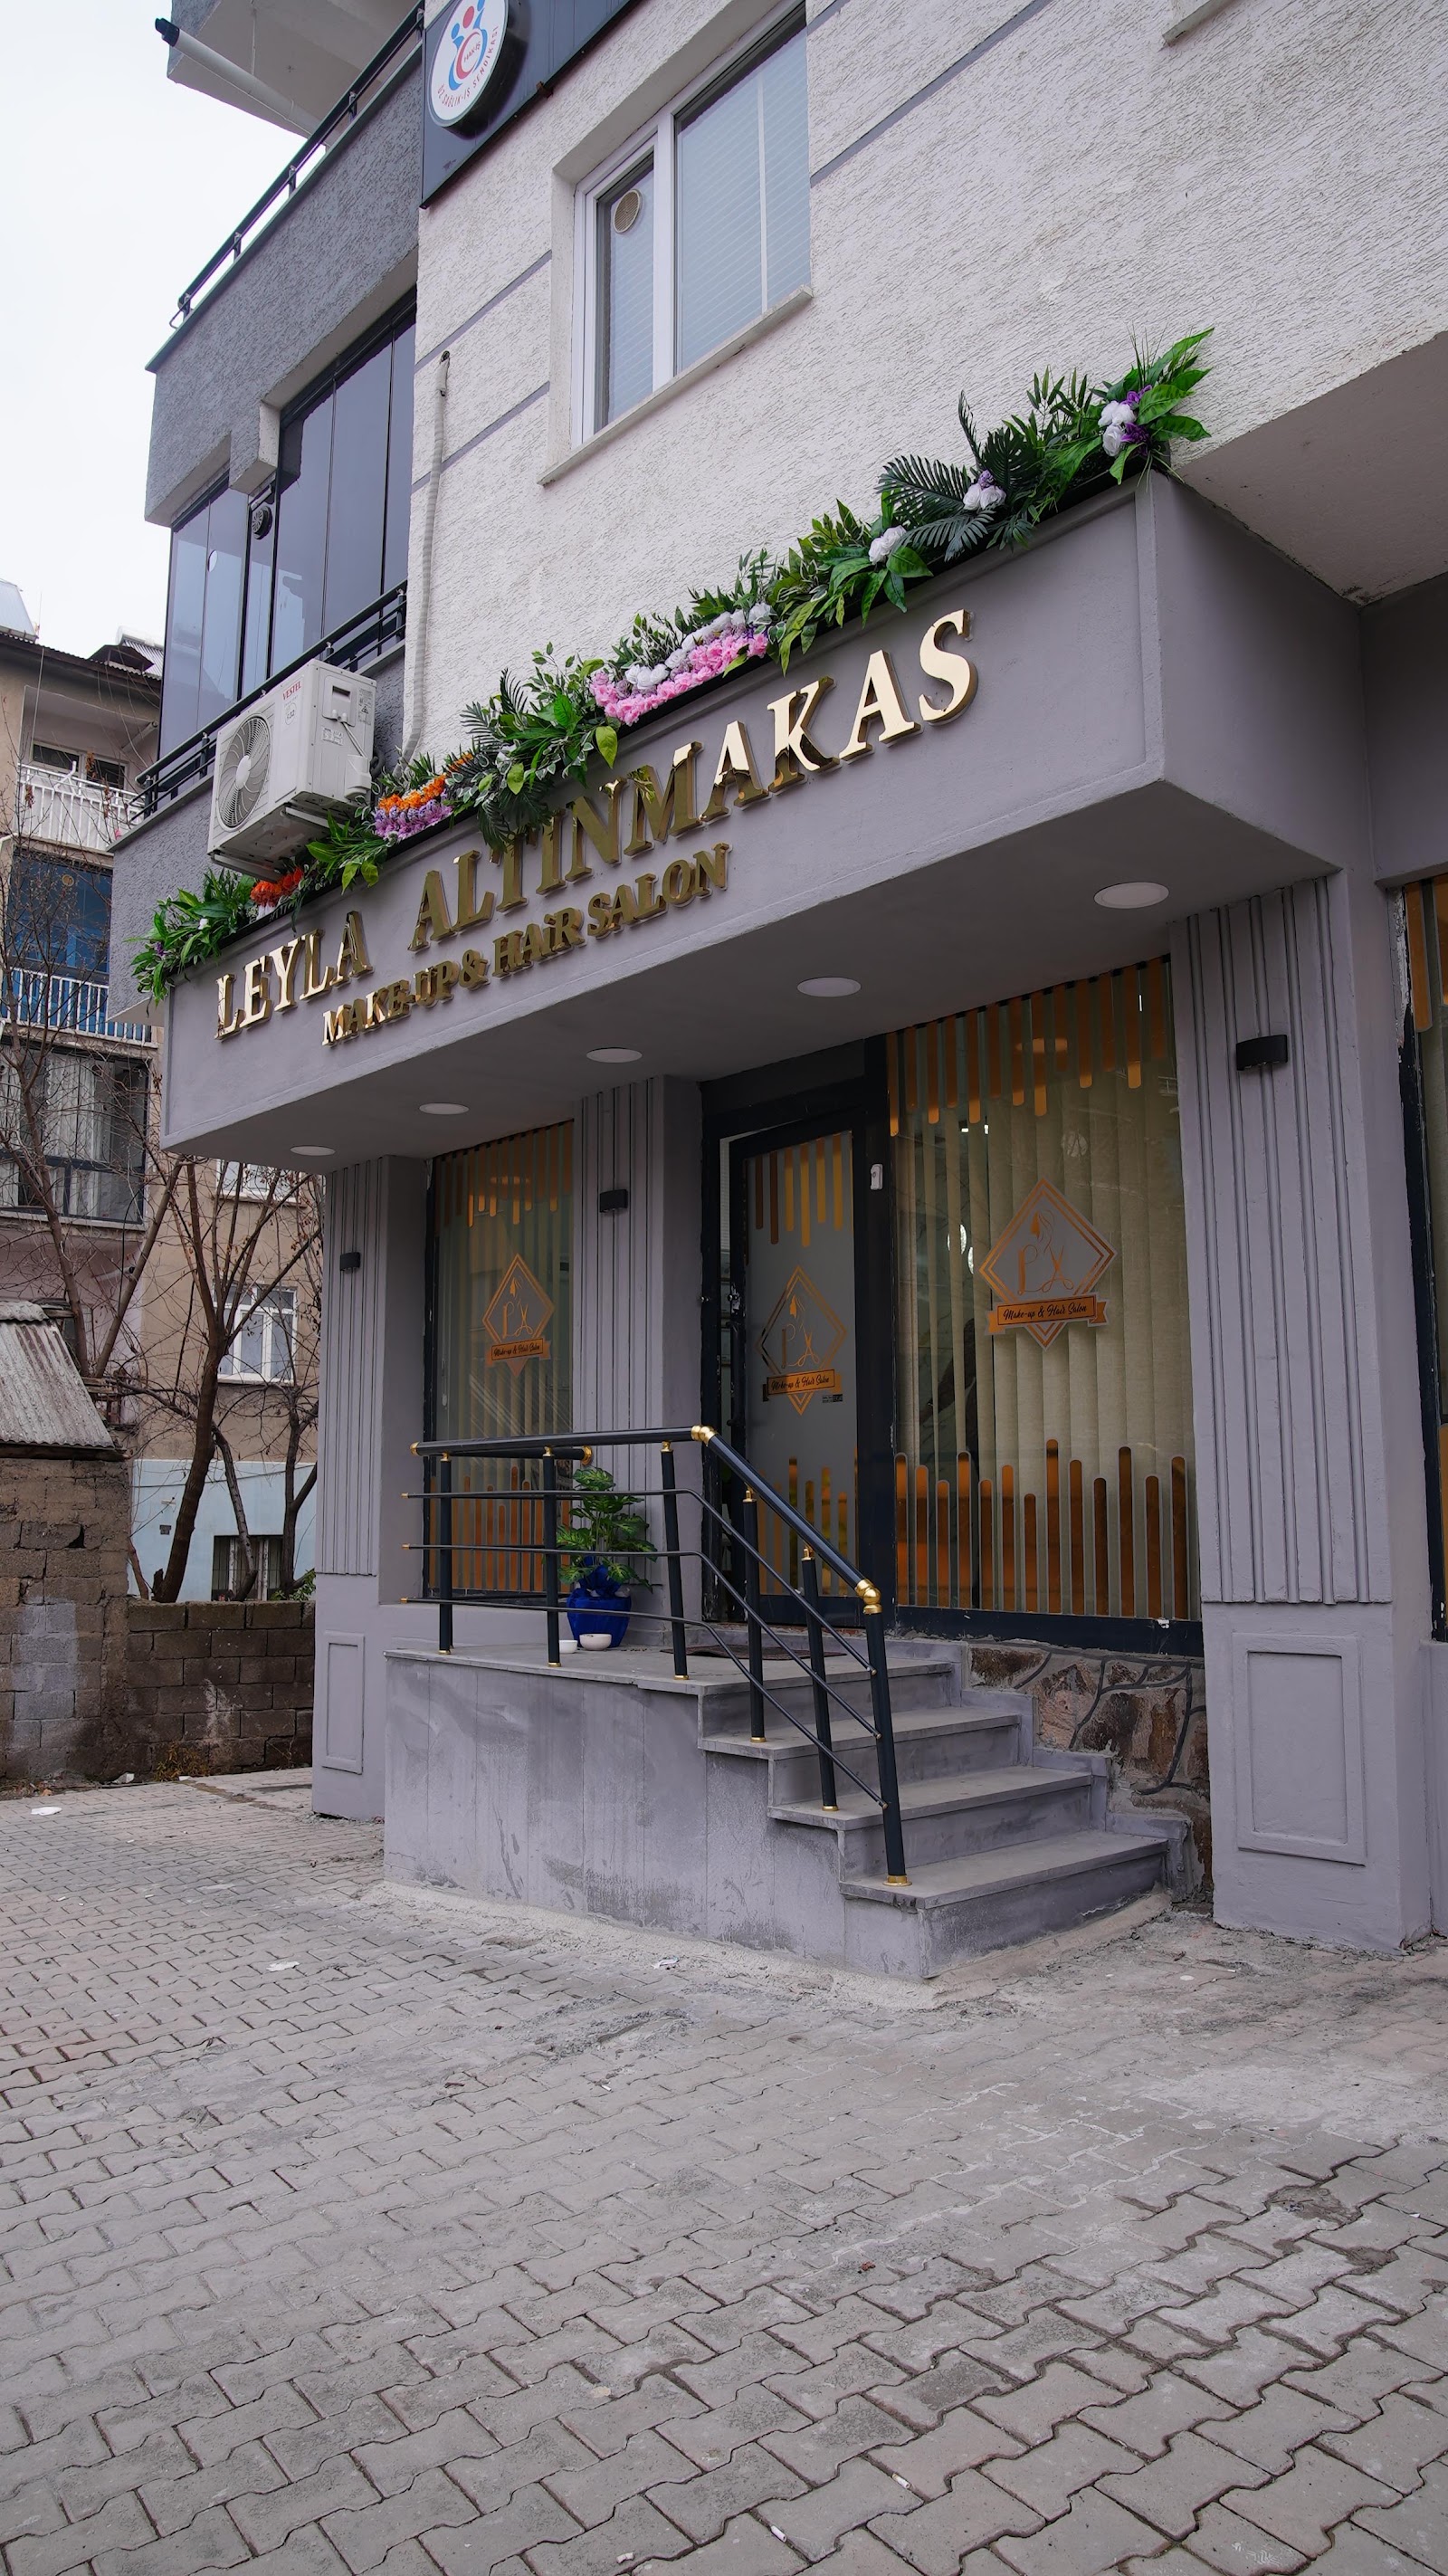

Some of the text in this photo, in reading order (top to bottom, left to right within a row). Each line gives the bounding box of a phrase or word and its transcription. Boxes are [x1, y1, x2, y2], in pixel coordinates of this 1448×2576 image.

[282, 681, 302, 701] VESTEL
[214, 608, 979, 1041] LEYLA ALTINMAKAS
[321, 959, 459, 1047] MAKE-UP
[458, 949, 491, 991] &
[587, 842, 733, 940] SALON
[1003, 1308, 1035, 1321] Make-up
[1037, 1306, 1045, 1318] &
[1067, 1302, 1087, 1315] Salon
[795, 1377, 801, 1388] &
